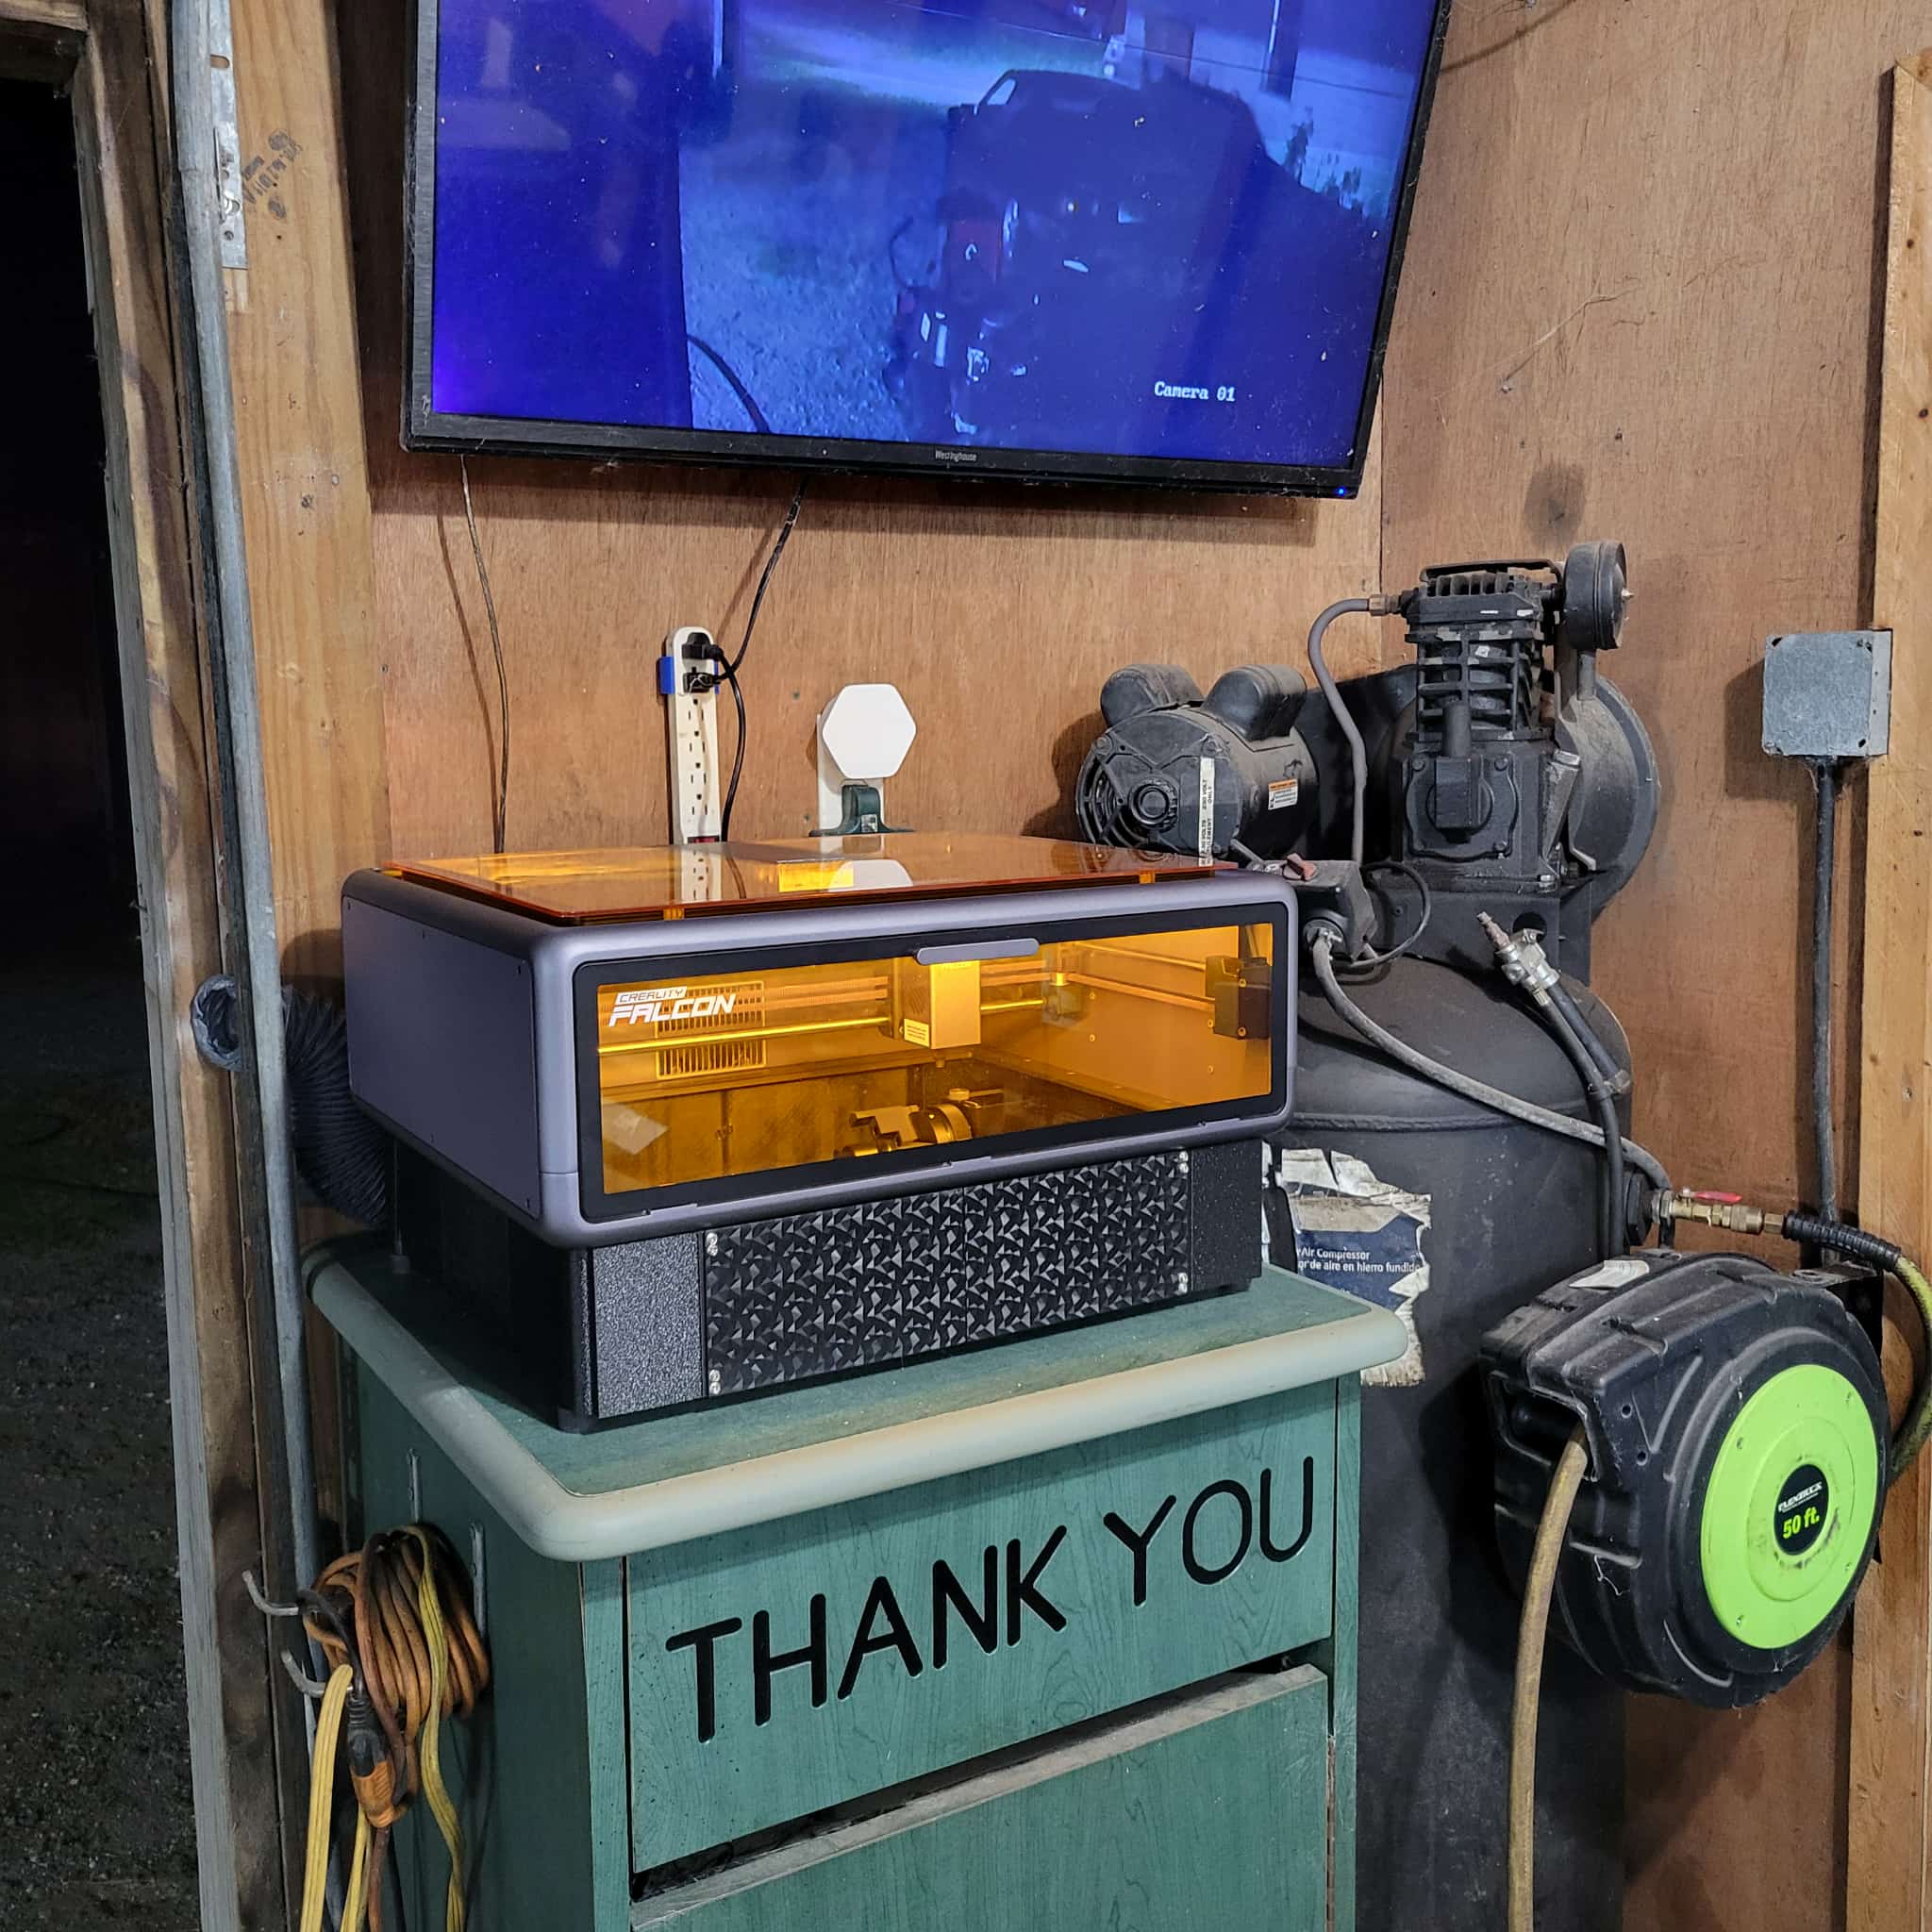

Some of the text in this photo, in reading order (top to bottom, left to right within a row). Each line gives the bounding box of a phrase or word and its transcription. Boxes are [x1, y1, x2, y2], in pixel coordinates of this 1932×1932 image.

[1154, 380, 1236, 402] Camera 01
[618, 988, 686, 1004] CREALITY
[608, 993, 736, 1026] FALCON
[1301, 1246, 1315, 1257] Air
[1316, 1247, 1371, 1261] Compressor
[1309, 1259, 1322, 1270] de
[1342, 1263, 1355, 1272] en
[1357, 1261, 1384, 1273] hierro
[1782, 1514, 1802, 1540] 50
[665, 1456, 1314, 1743] THANK YOU
